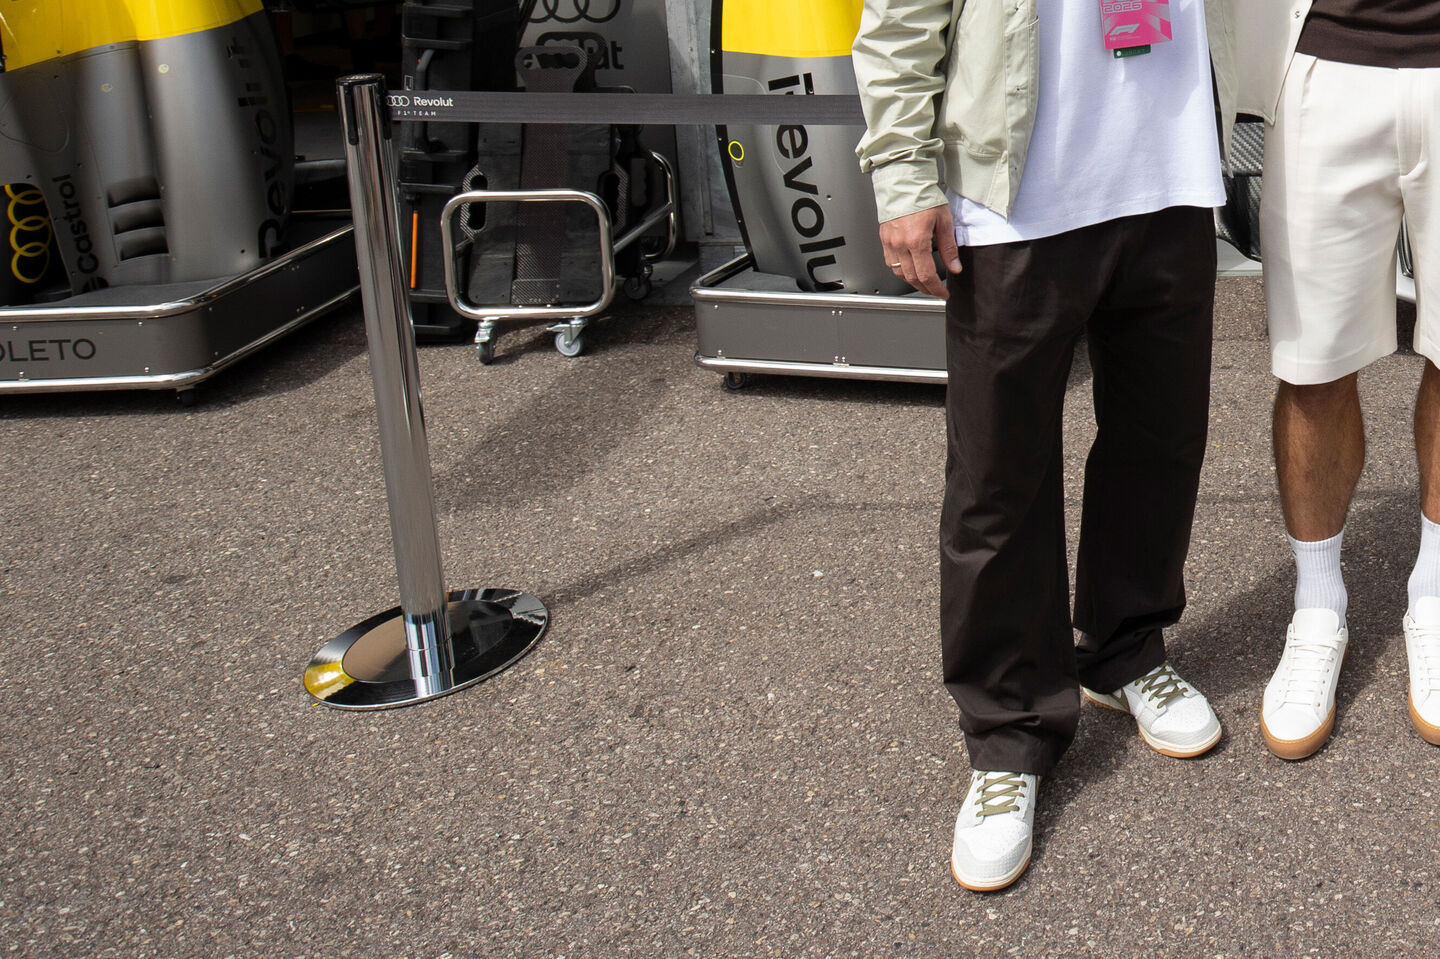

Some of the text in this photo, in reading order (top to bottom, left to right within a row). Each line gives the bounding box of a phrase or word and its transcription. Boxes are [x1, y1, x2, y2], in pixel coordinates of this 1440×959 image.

[1103, 1, 1143, 14] 2026
[413, 95, 454, 108] Revolut
[52, 174, 100, 275] Castrol
[0, 338, 97, 362] LETO
